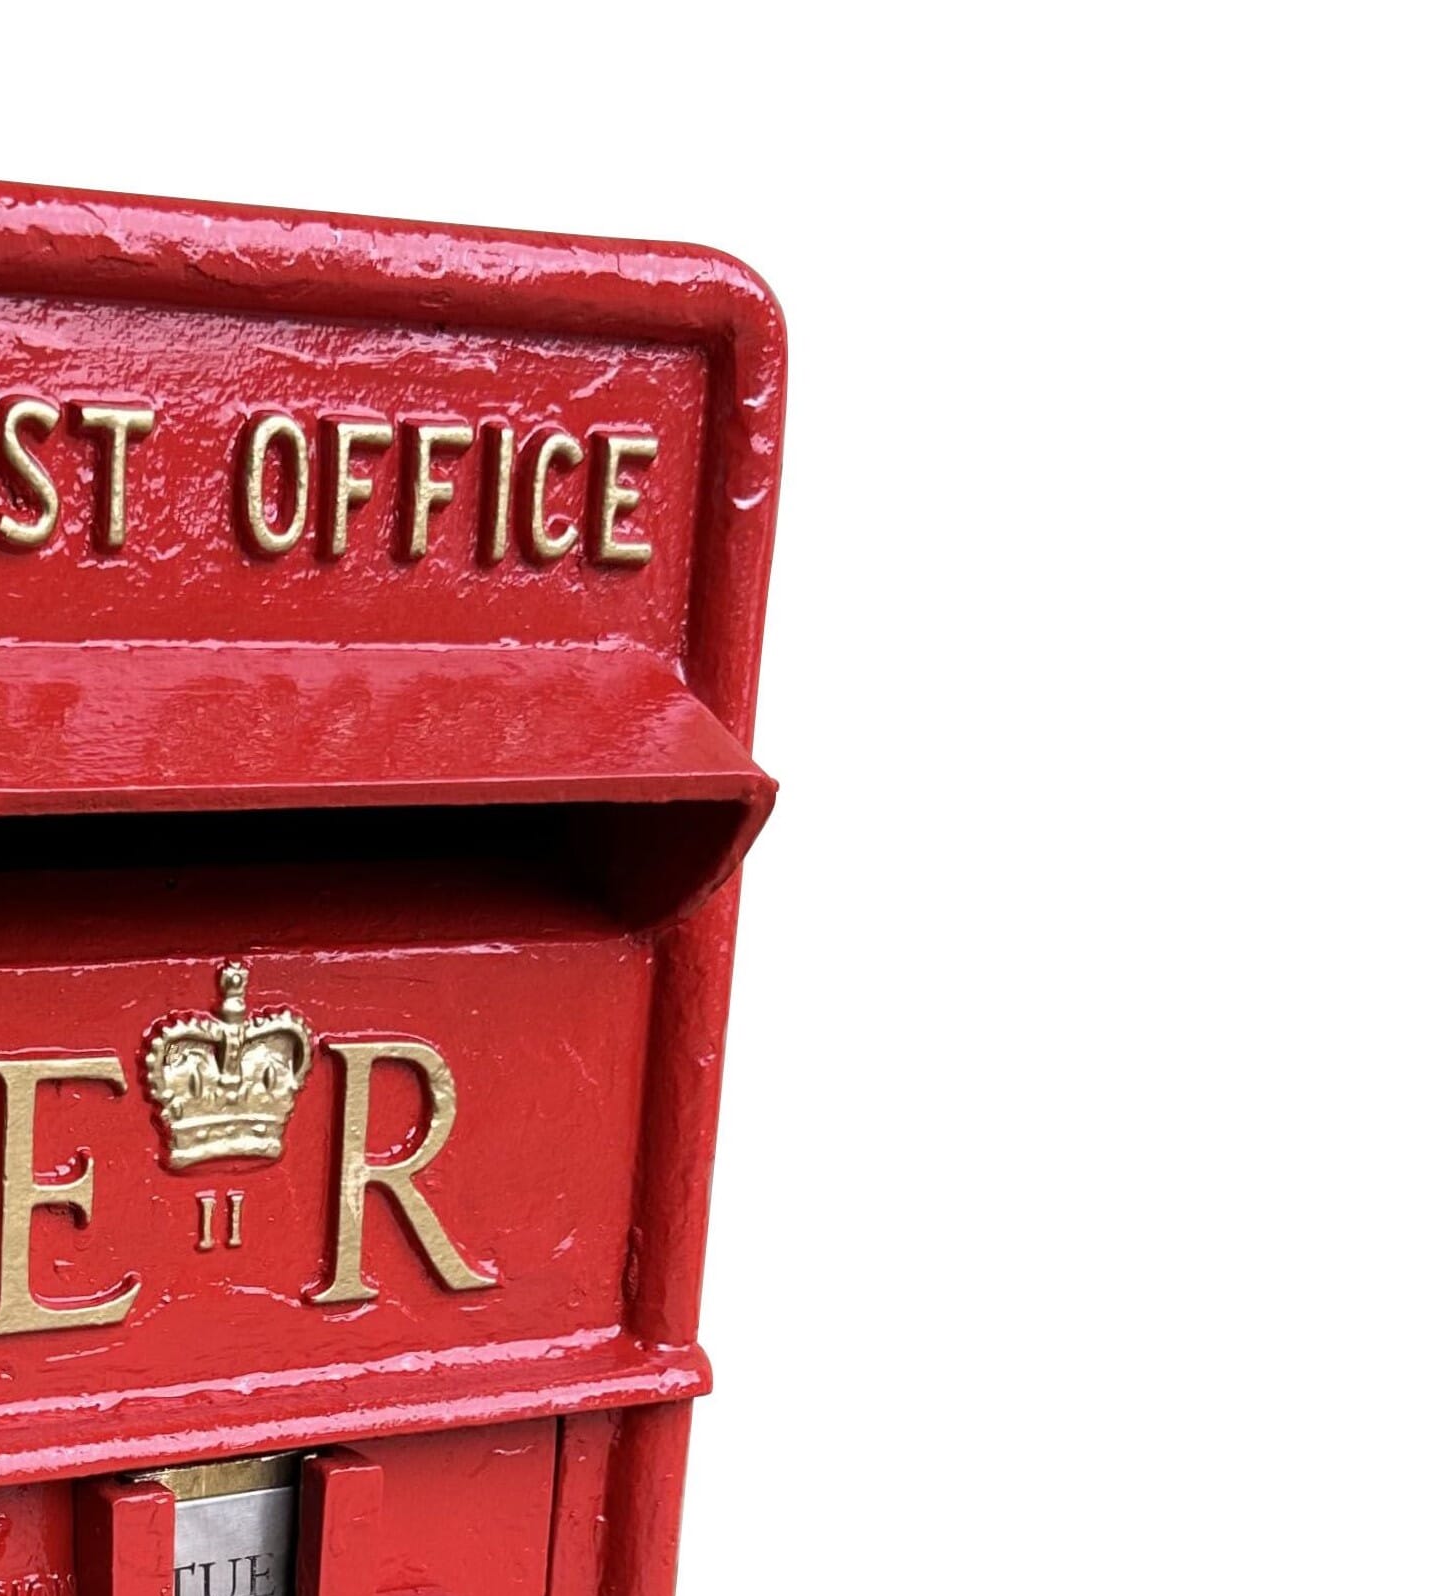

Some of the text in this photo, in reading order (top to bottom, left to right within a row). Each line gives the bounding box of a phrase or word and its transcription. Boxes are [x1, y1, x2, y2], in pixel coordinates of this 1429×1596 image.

[237, 412, 658, 566] OFFICE
[194, 1190, 244, 1250] II
[308, 1040, 498, 1304] R
